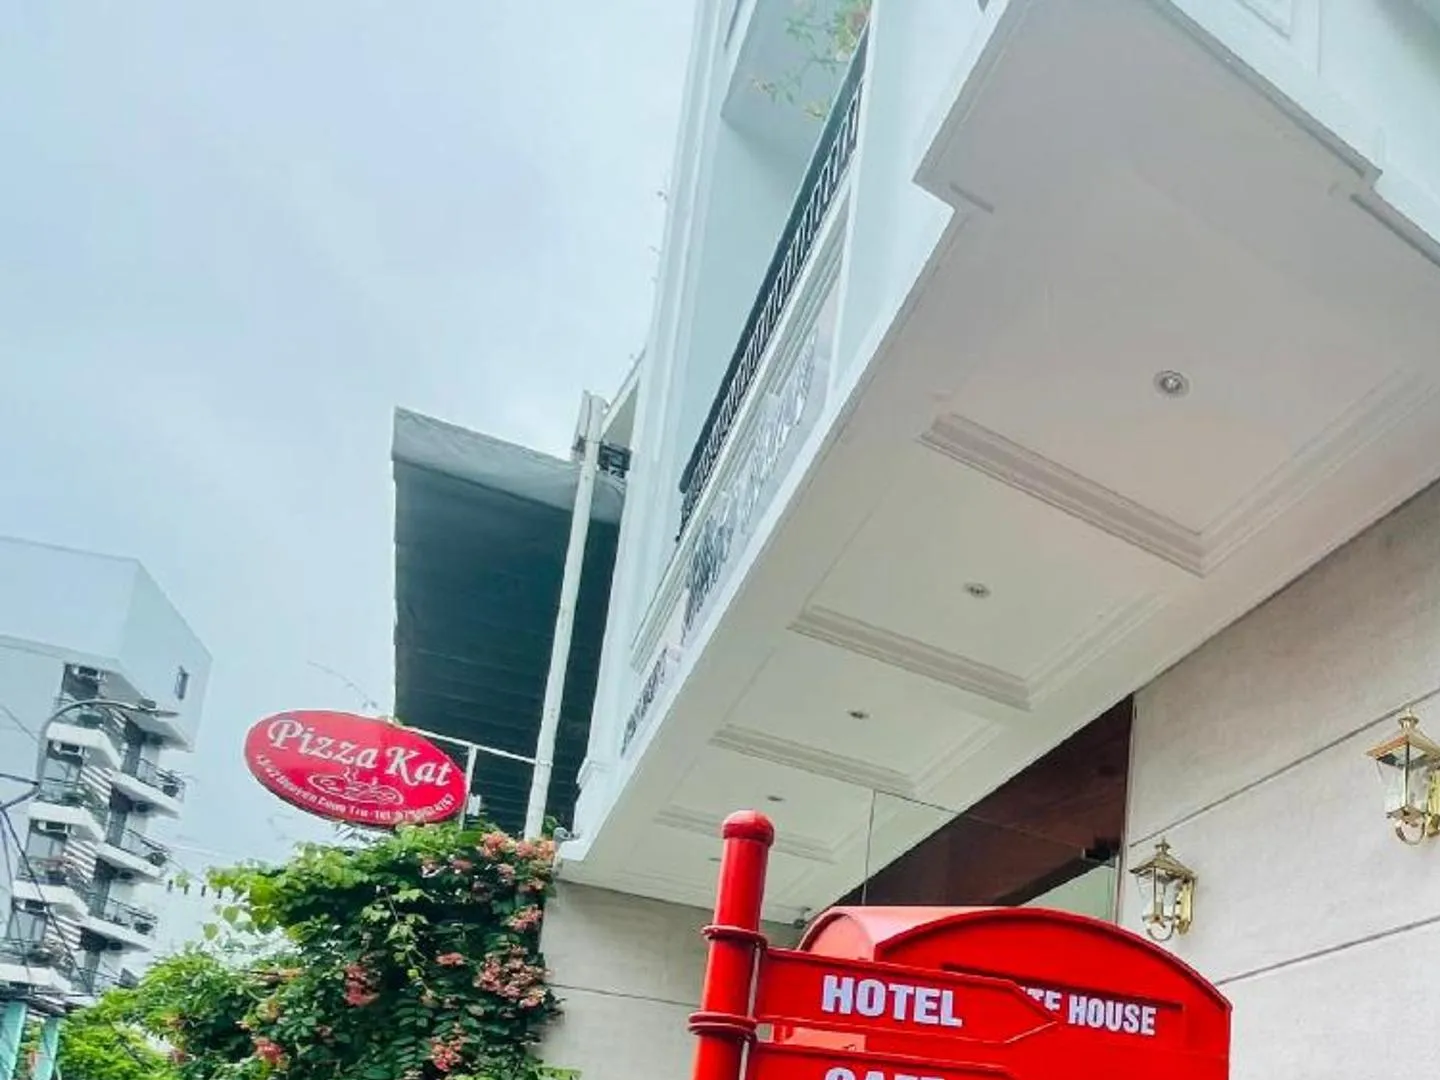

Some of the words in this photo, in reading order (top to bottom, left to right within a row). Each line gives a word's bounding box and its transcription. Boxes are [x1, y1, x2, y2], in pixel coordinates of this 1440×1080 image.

[267, 718, 378, 769] Pizza
[386, 745, 453, 787] Kat
[821, 974, 963, 1028] HOTEL
[1067, 994, 1157, 1036] HOUSE
